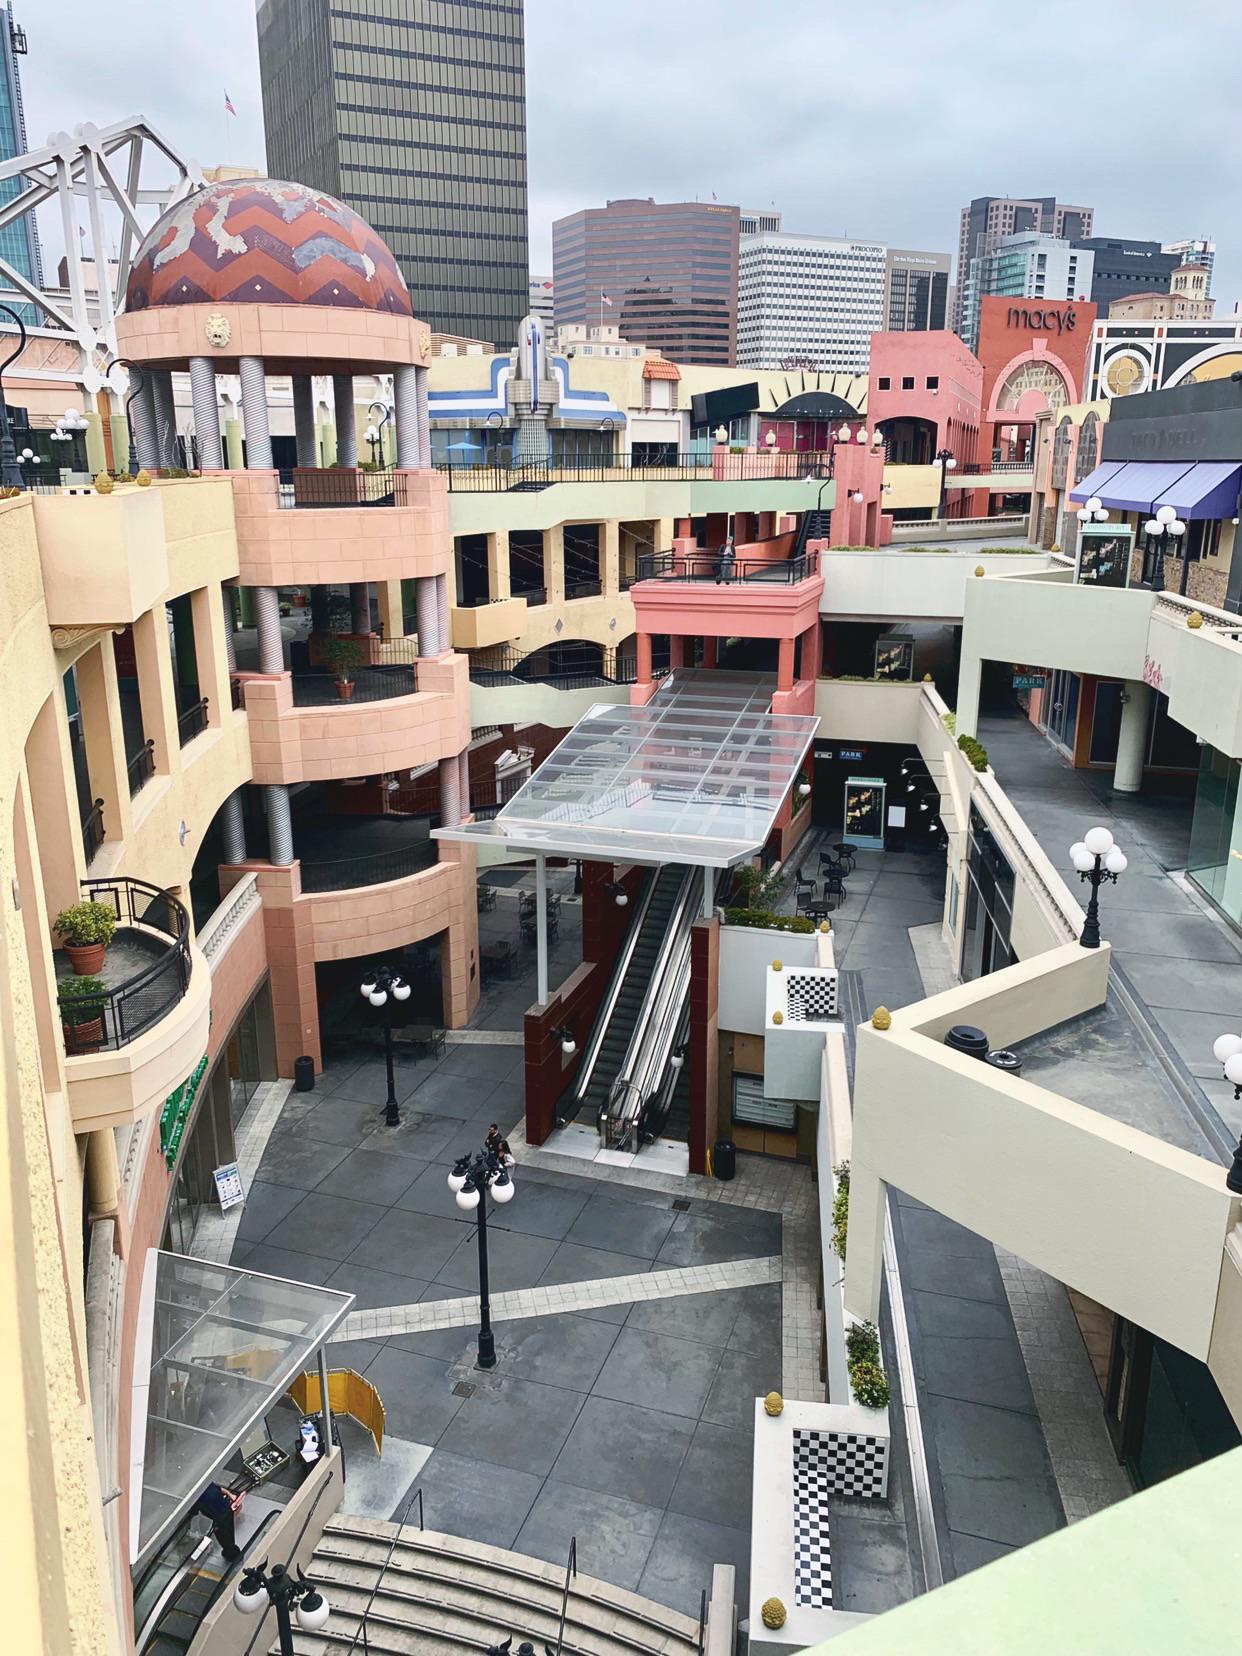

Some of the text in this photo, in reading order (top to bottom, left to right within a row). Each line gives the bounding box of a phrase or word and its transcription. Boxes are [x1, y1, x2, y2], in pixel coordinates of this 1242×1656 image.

[855, 245, 883, 254] PROCOPIO
[1007, 305, 1076, 336] macy's
[1015, 676, 1044, 685] PARK
